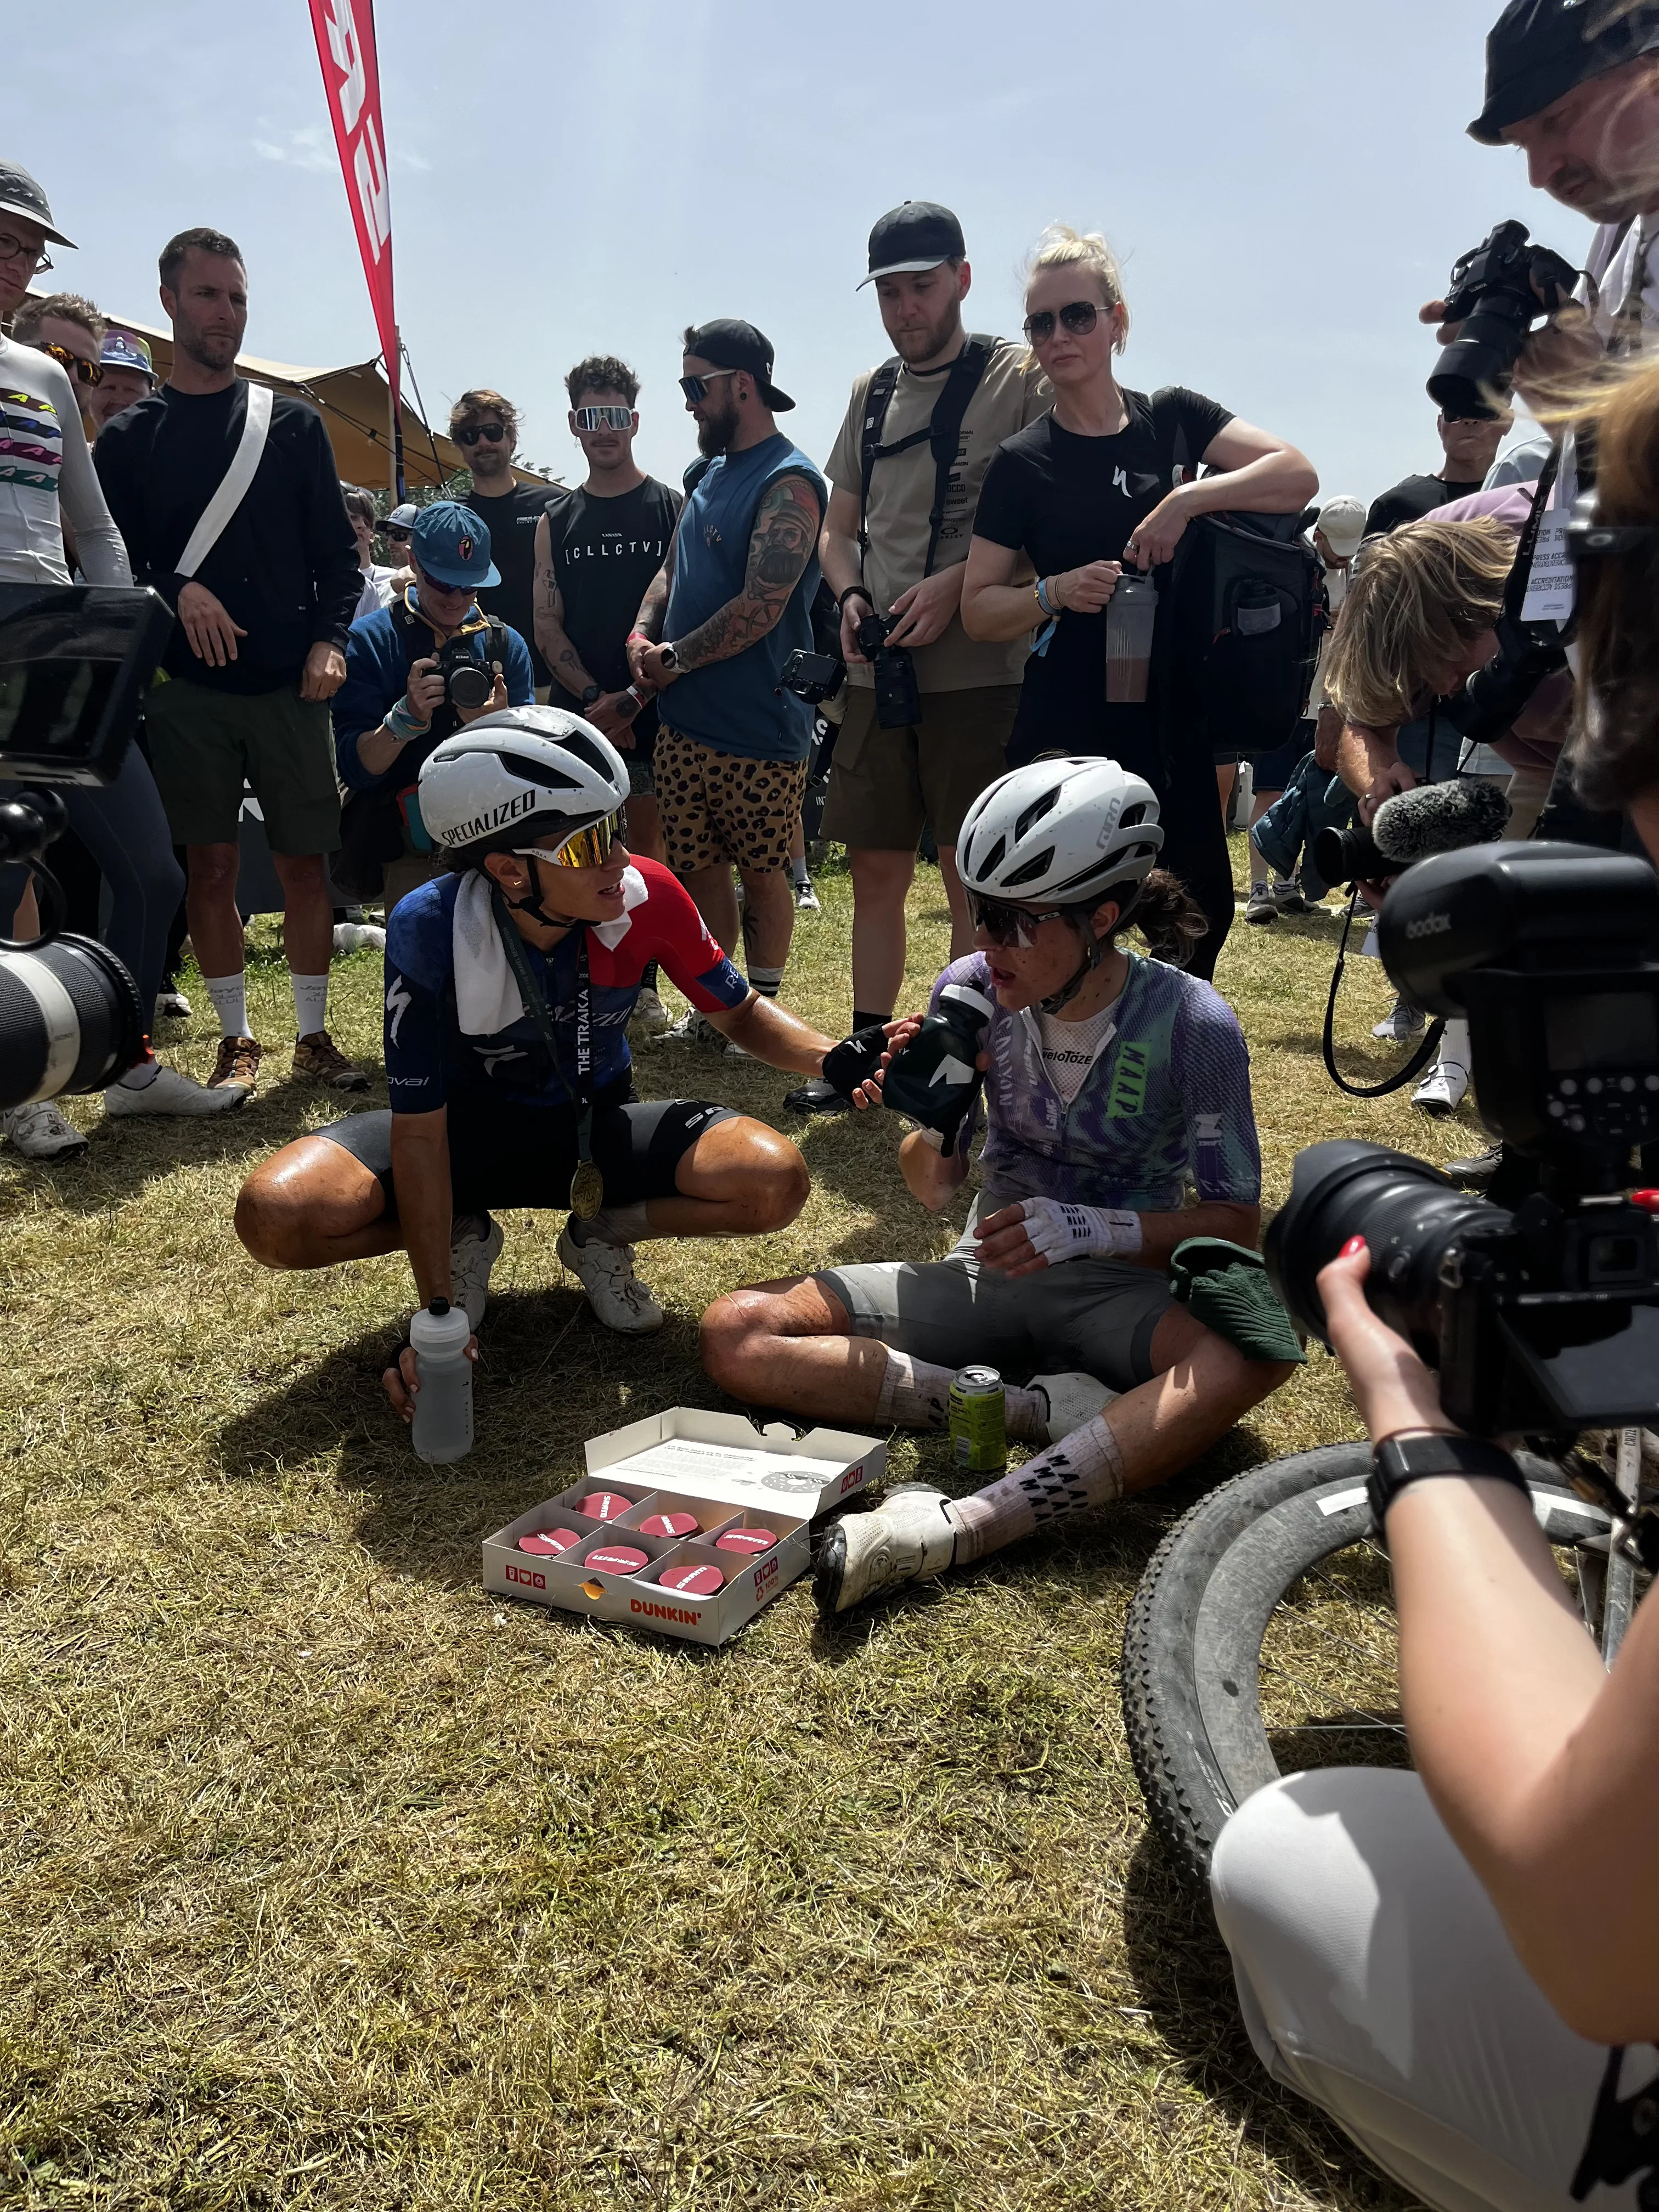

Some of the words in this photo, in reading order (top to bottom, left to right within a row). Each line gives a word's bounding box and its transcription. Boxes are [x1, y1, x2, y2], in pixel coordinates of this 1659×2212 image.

[441, 789, 535, 847] SPECIALIZED
[1096, 797, 1121, 850] GIRO
[578, 989, 589, 1045] TRAKA
[578, 1048, 590, 1075] THE
[995, 1015, 1013, 1105] CANYON
[1115, 1045, 1146, 1114] MAAP
[600, 1496, 611, 1518] SRAM
[724, 1534, 769, 1545] SRAM
[592, 1555, 640, 1567] SRAM
[676, 1566, 708, 1589] SRAM
[630, 1599, 702, 1626] DUNKIN'
